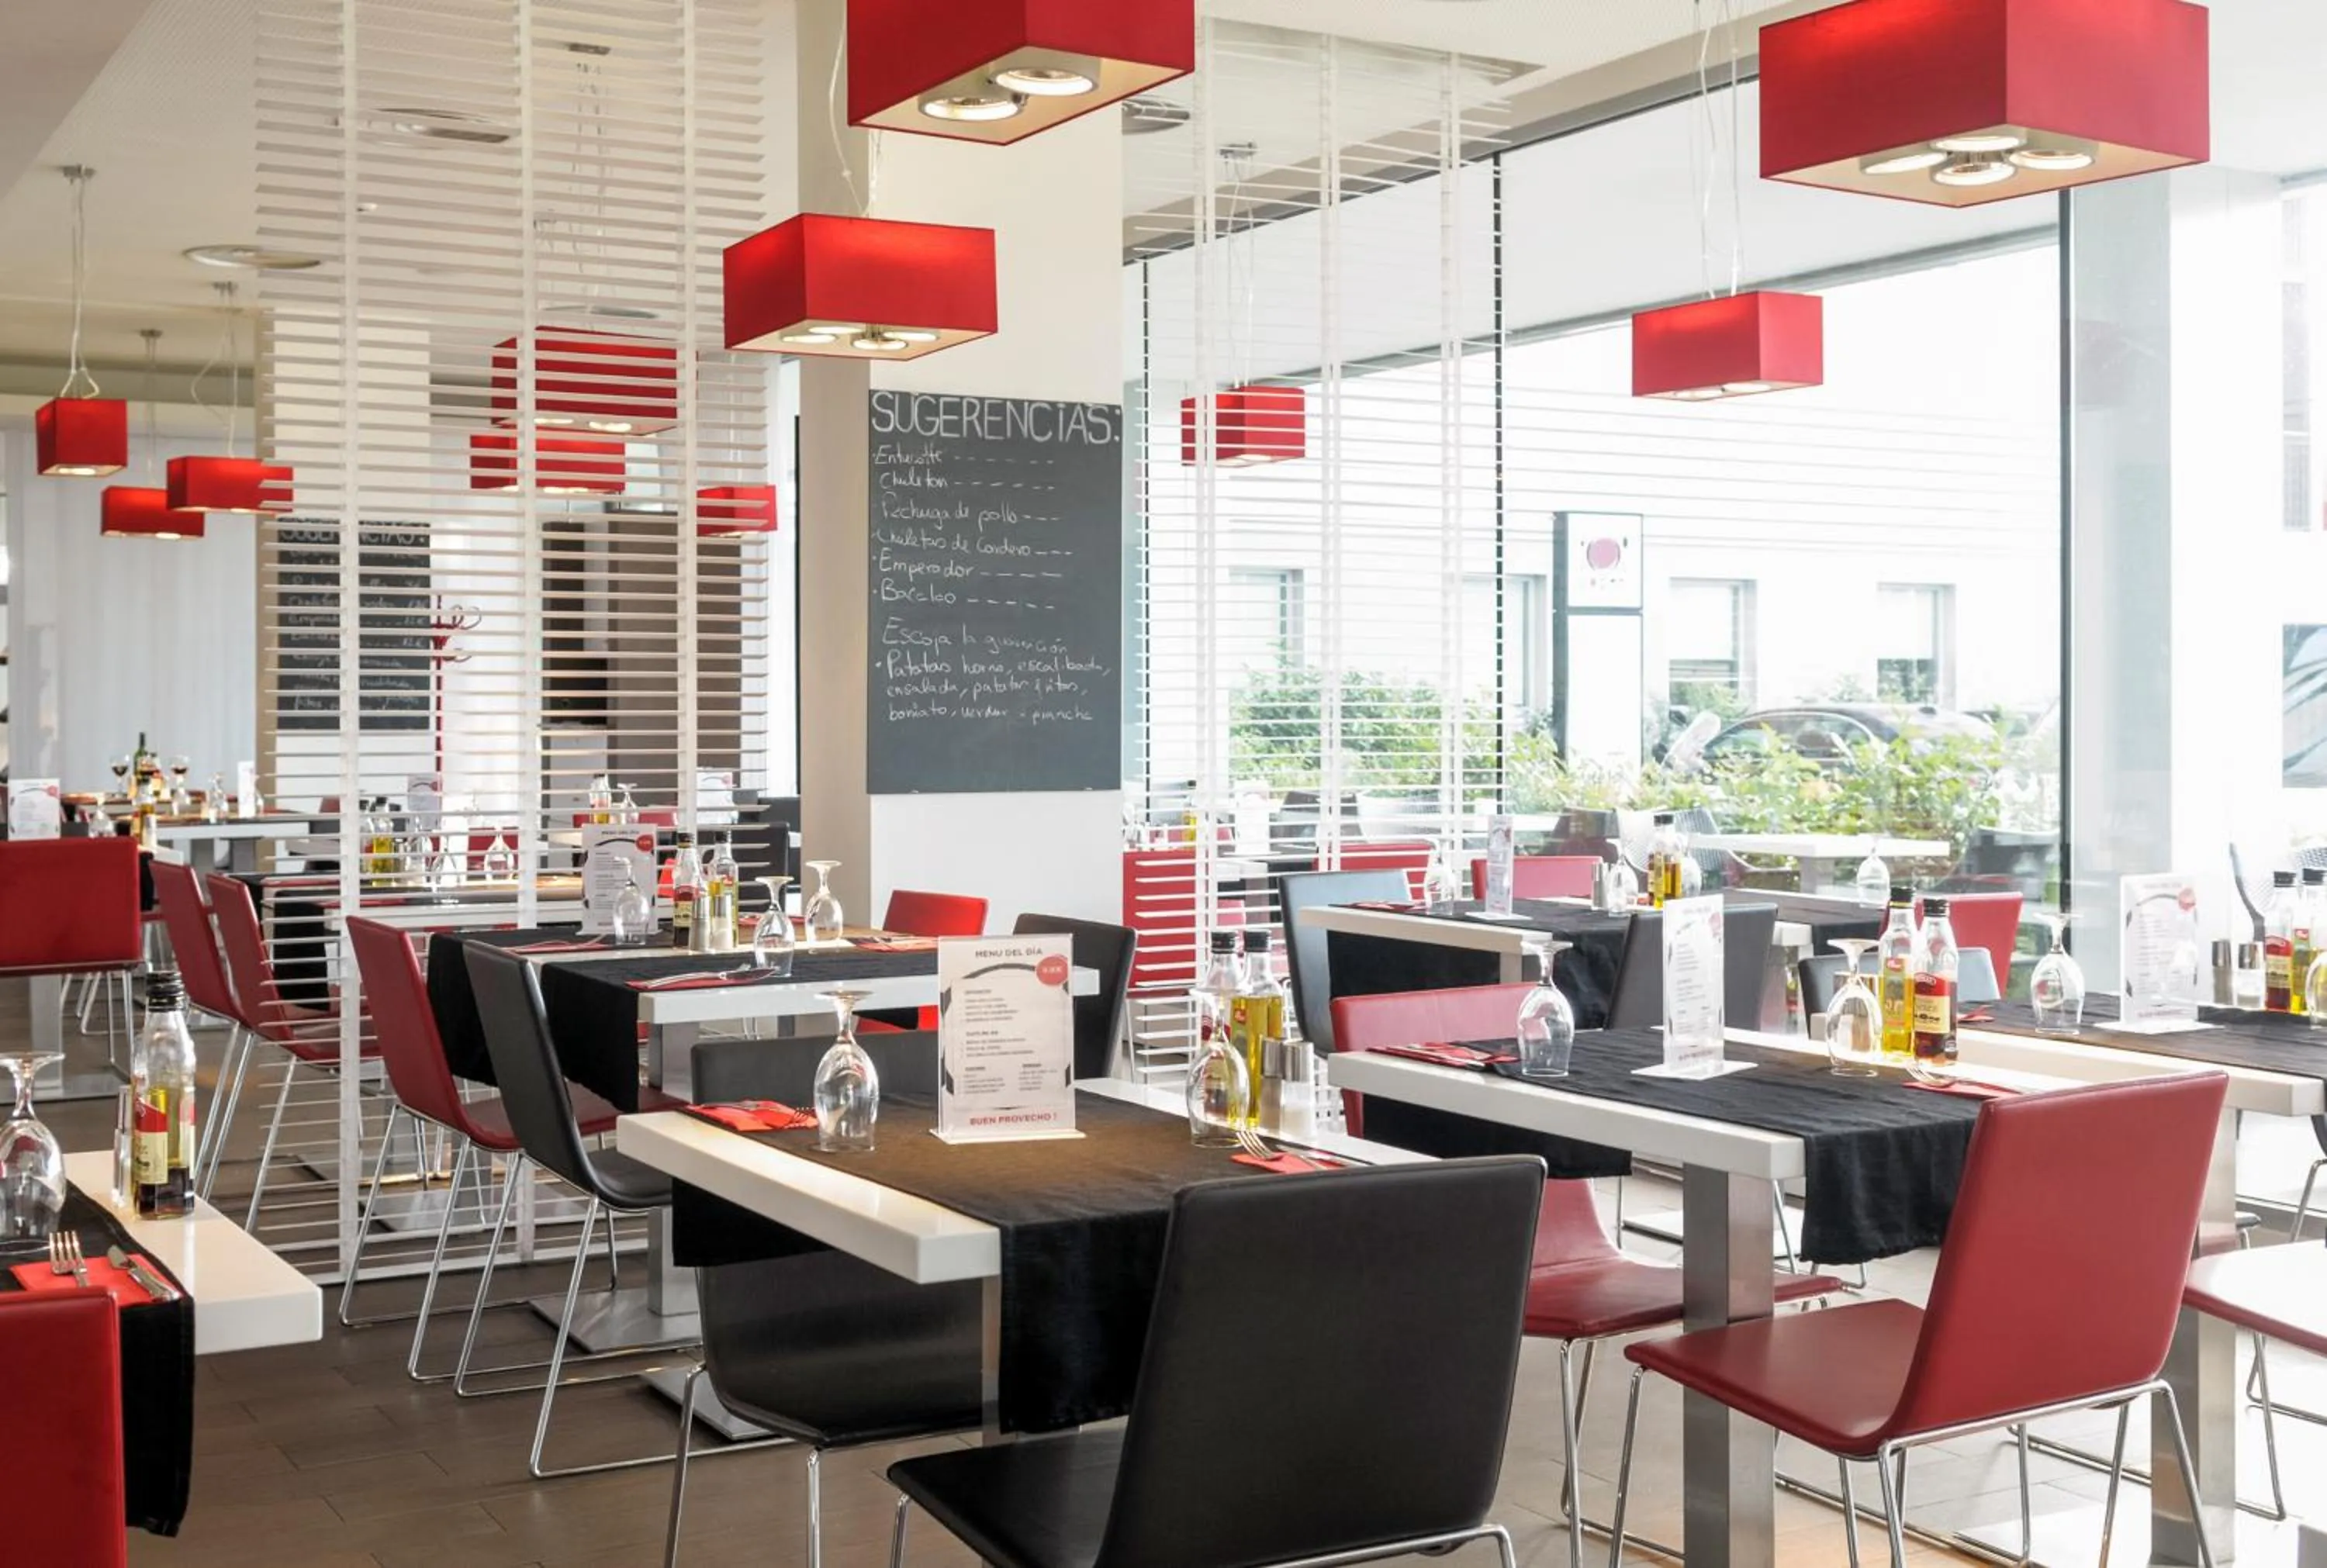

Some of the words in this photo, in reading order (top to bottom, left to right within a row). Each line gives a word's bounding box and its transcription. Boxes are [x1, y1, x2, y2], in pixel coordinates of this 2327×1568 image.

[978, 503, 1017, 533] pollo
[880, 547, 974, 582] Emperador
[882, 616, 952, 656] Escoja
[887, 648, 951, 679] Patatas
[975, 949, 1003, 958] MENU
[970, 1116, 996, 1126] BUEN
[998, 1113, 1052, 1124] PROVECHO
